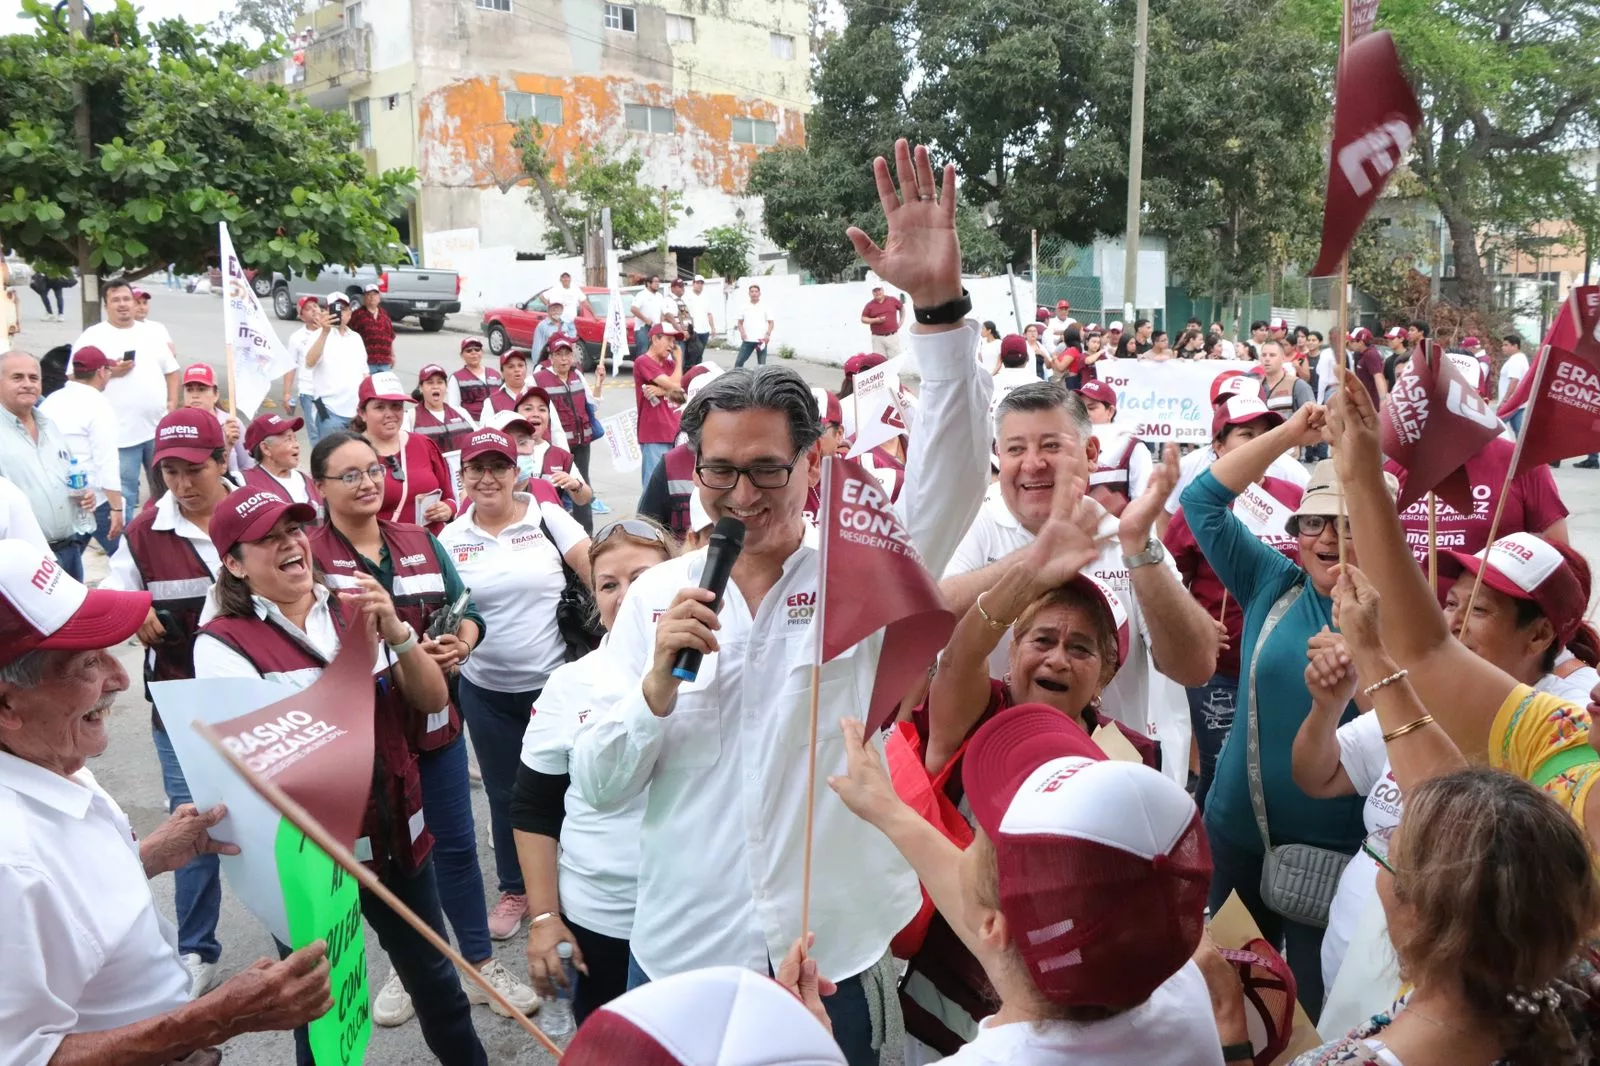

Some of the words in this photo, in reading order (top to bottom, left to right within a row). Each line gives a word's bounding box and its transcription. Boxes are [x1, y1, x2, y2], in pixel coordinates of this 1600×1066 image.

[857, 371, 885, 390] ERASMO
[1105, 376, 1130, 386] Por
[160, 425, 199, 437] morena
[1175, 427, 1208, 438] para
[472, 432, 509, 444] morena
[1398, 513, 1440, 522] RESIDENE
[511, 532, 544, 545] ERASMO
[839, 528, 902, 554] PRESIDENTE
[1405, 532, 1467, 546] moena
[453, 544, 485, 554] morena
